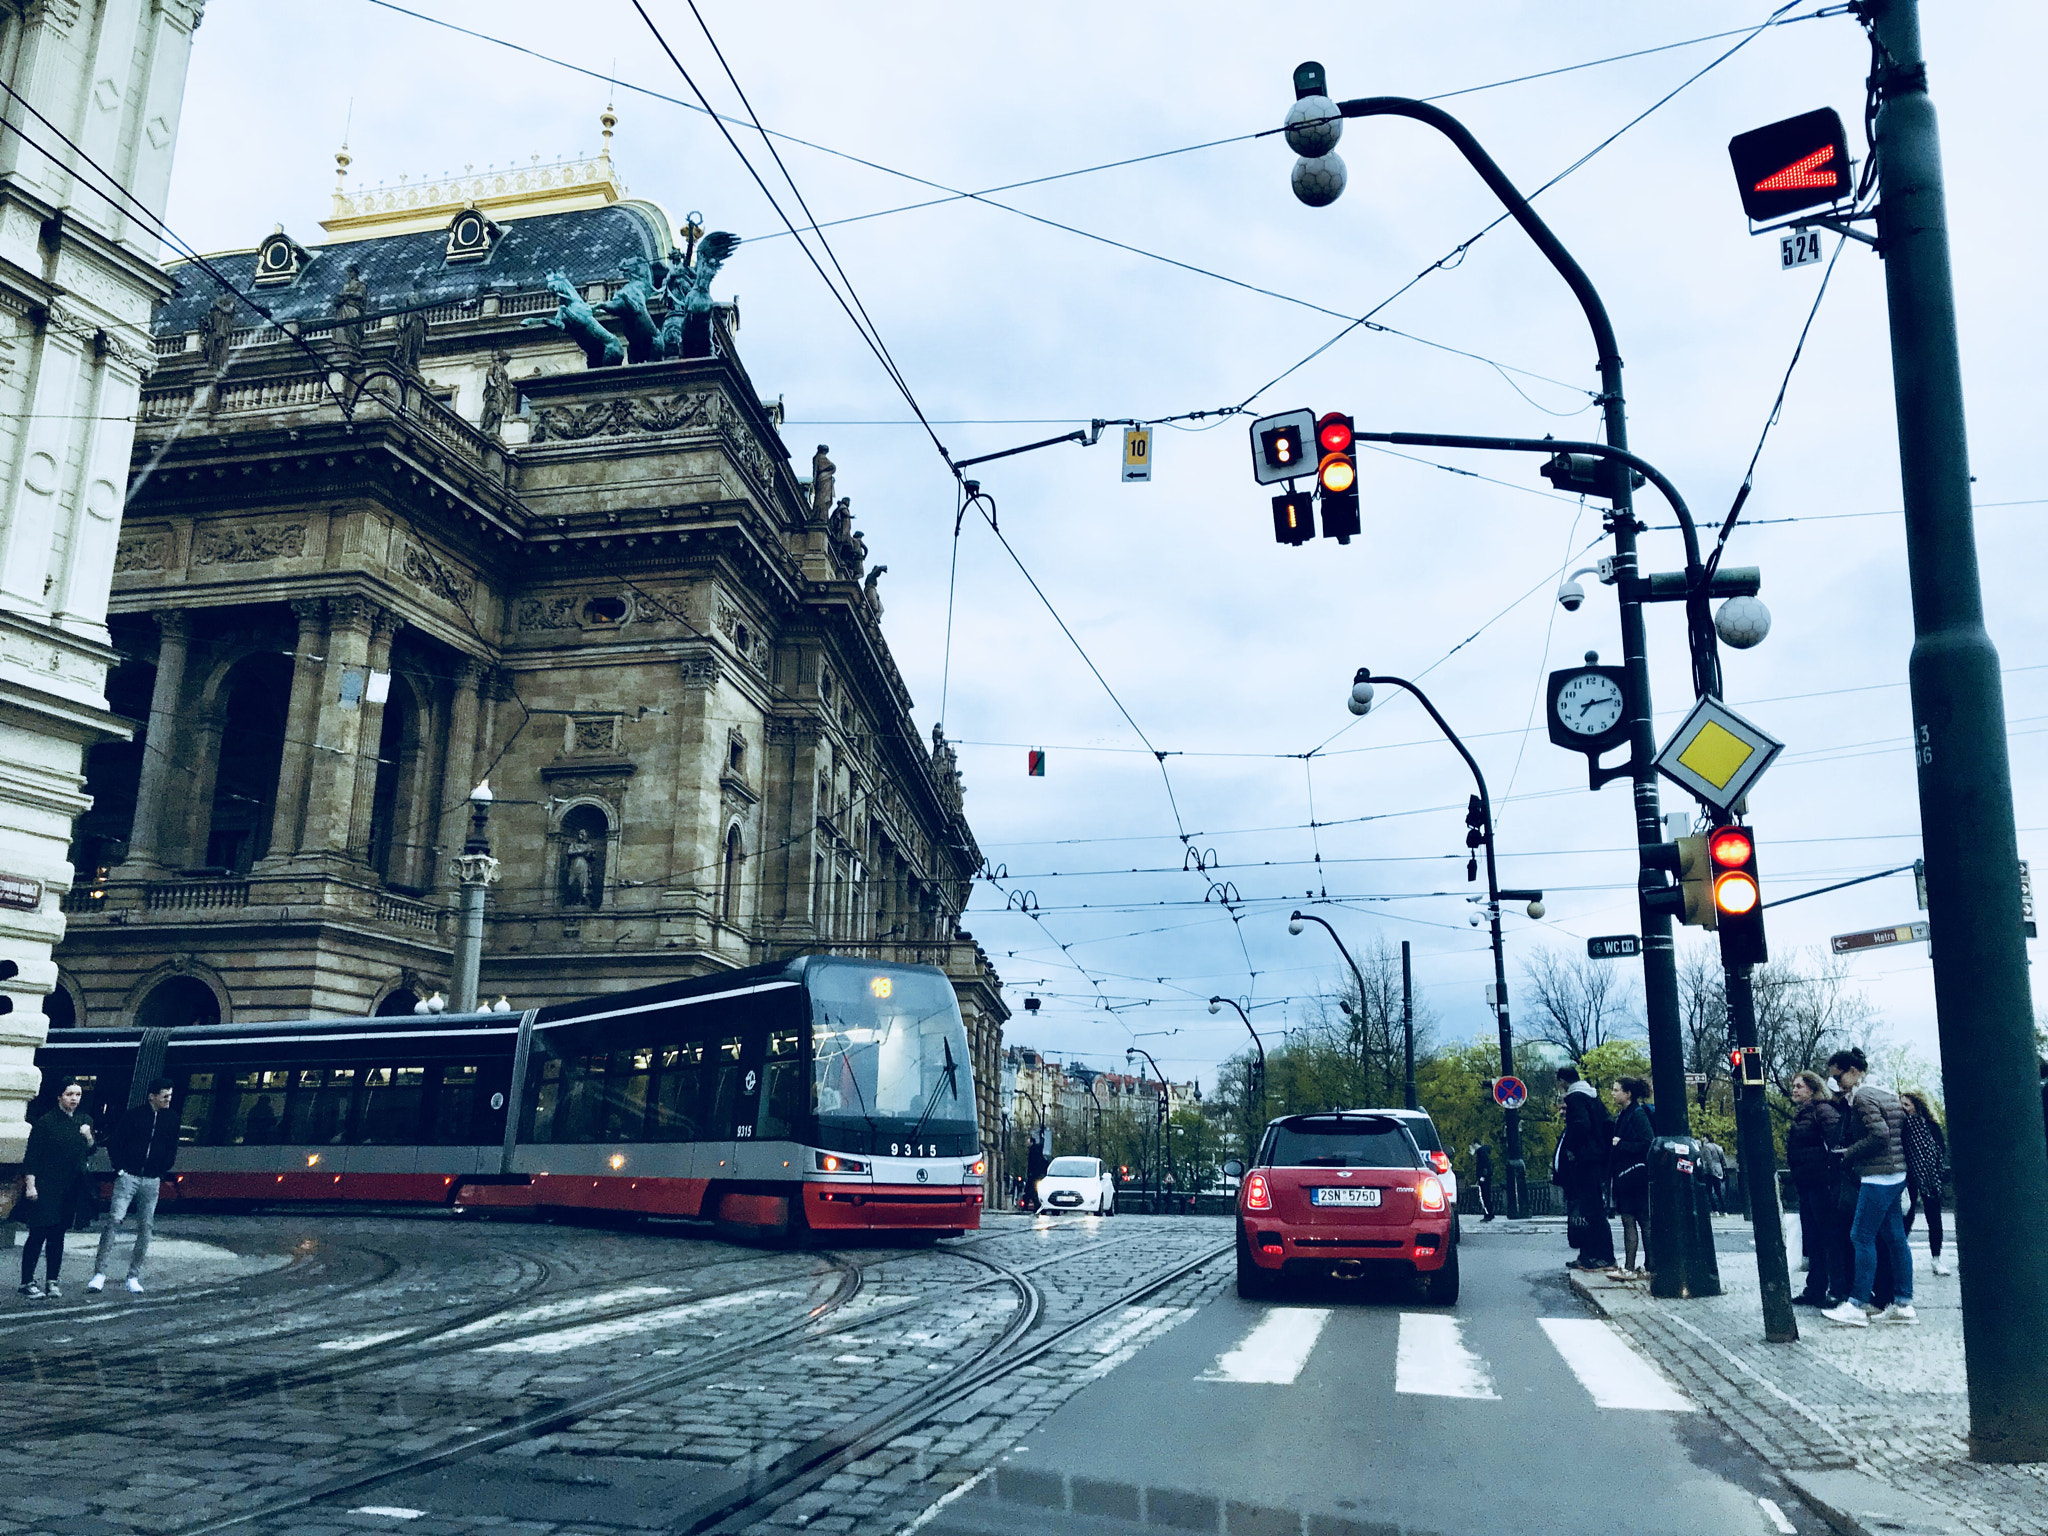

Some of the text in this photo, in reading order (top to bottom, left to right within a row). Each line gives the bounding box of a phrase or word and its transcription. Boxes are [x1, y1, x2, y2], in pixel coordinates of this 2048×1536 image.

[1782, 233, 1820, 266] 524
[1130, 439, 1146, 457] 10
[1586, 677, 1596, 685] 12
[1565, 691, 1576, 699] 10
[1873, 932, 1896, 943] Metro
[1604, 940, 1620, 954] WC
[871, 977, 892, 998] 18
[737, 1125, 752, 1137] 9315
[890, 1142, 937, 1157] 9315
[1320, 1190, 1341, 1201] 2SN
[1348, 1190, 1376, 1202] 5750
